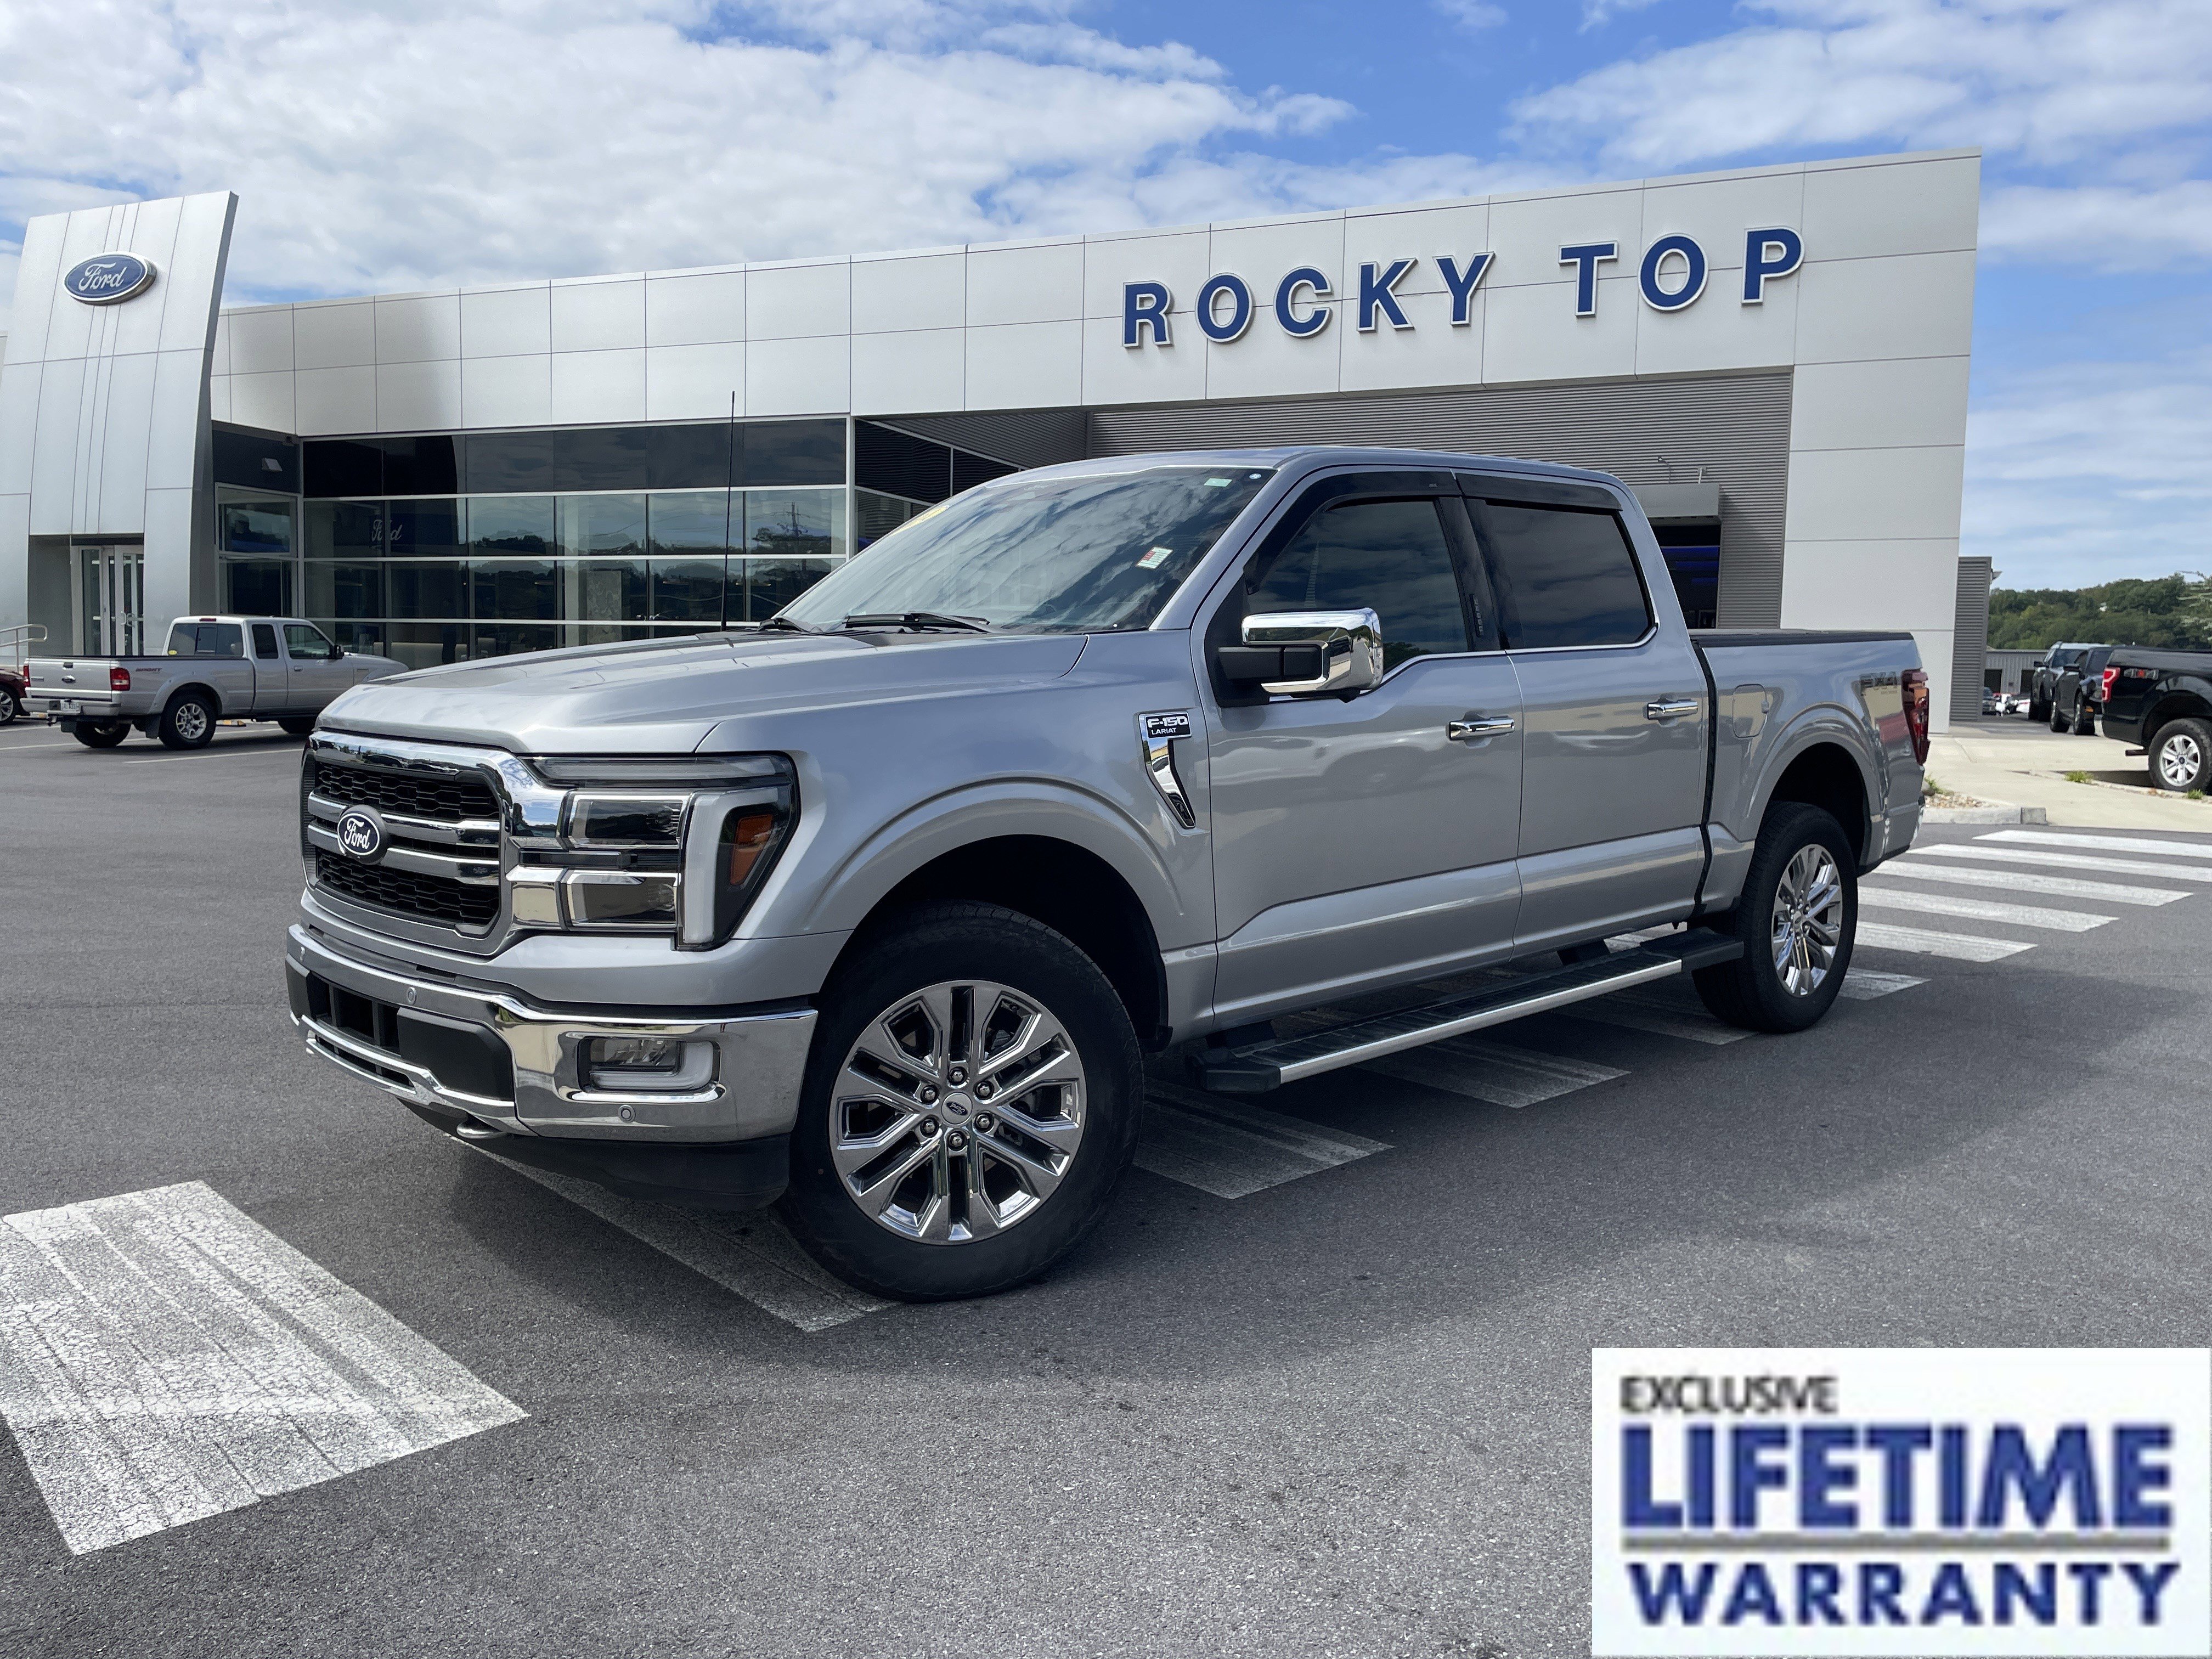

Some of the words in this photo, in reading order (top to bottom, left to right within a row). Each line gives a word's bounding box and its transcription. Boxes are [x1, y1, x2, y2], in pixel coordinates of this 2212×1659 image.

[78, 263, 127, 291] Ford
[1122, 251, 1496, 348] ROCKY
[1559, 225, 1805, 318] TOP
[1147, 715, 1188, 728] F-150
[344, 817, 371, 849] Ford
[949, 1103, 966, 1115] Ford
